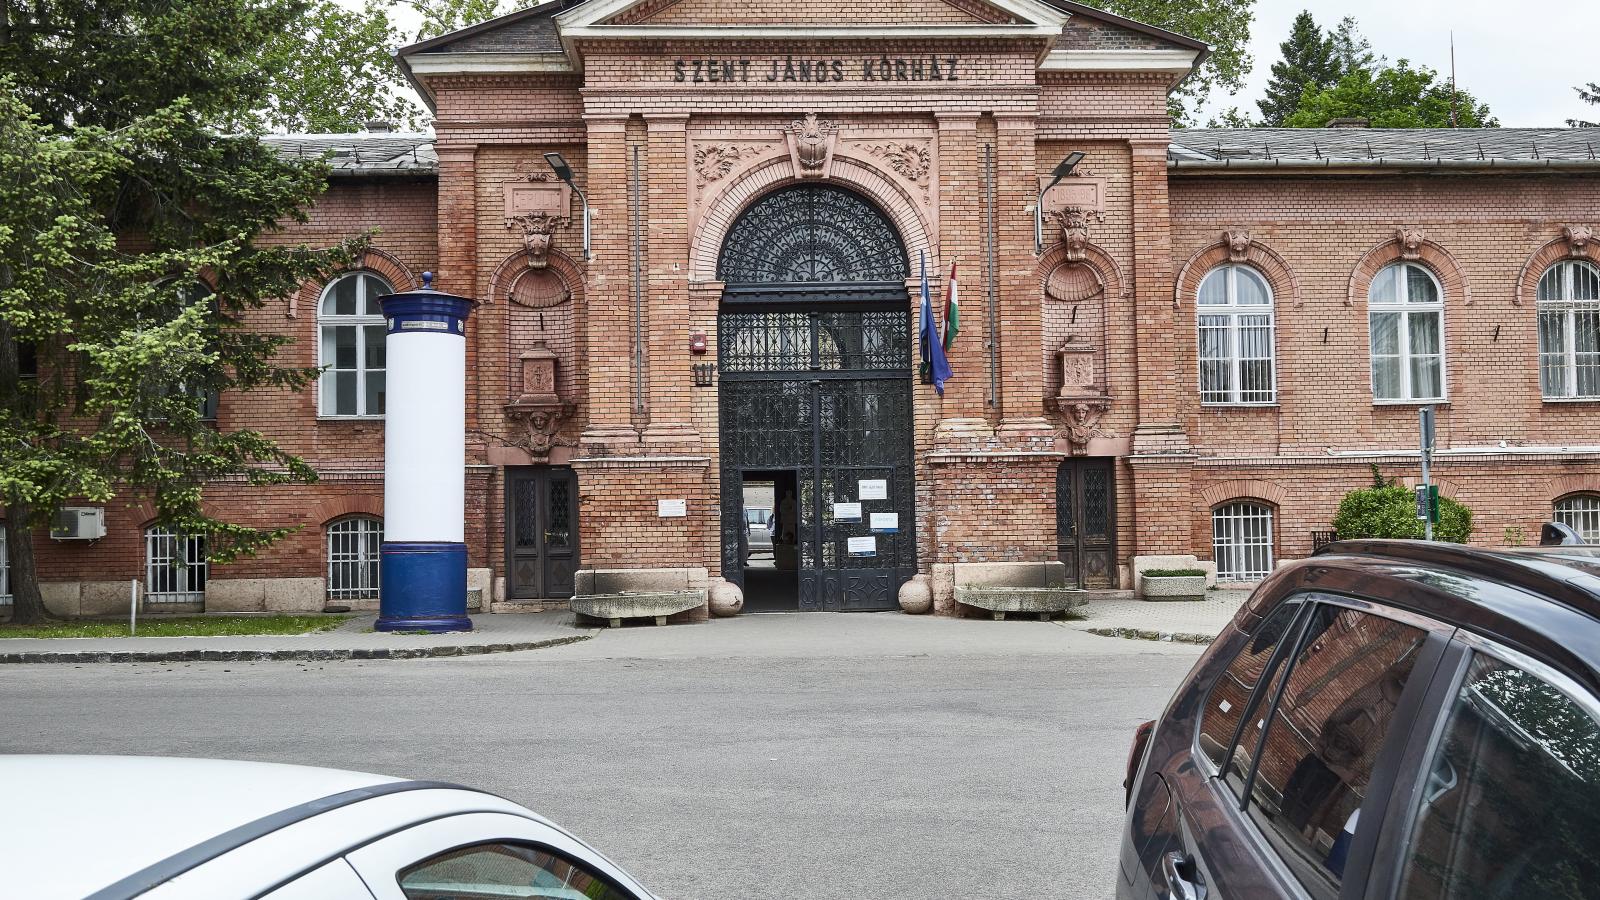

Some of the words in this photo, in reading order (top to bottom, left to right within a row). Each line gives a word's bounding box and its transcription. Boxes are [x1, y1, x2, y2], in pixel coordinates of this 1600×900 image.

[674, 60, 749, 82] SZENT
[767, 56, 843, 81] JÁNOS
[864, 55, 958, 81] KÓRHÁZ
